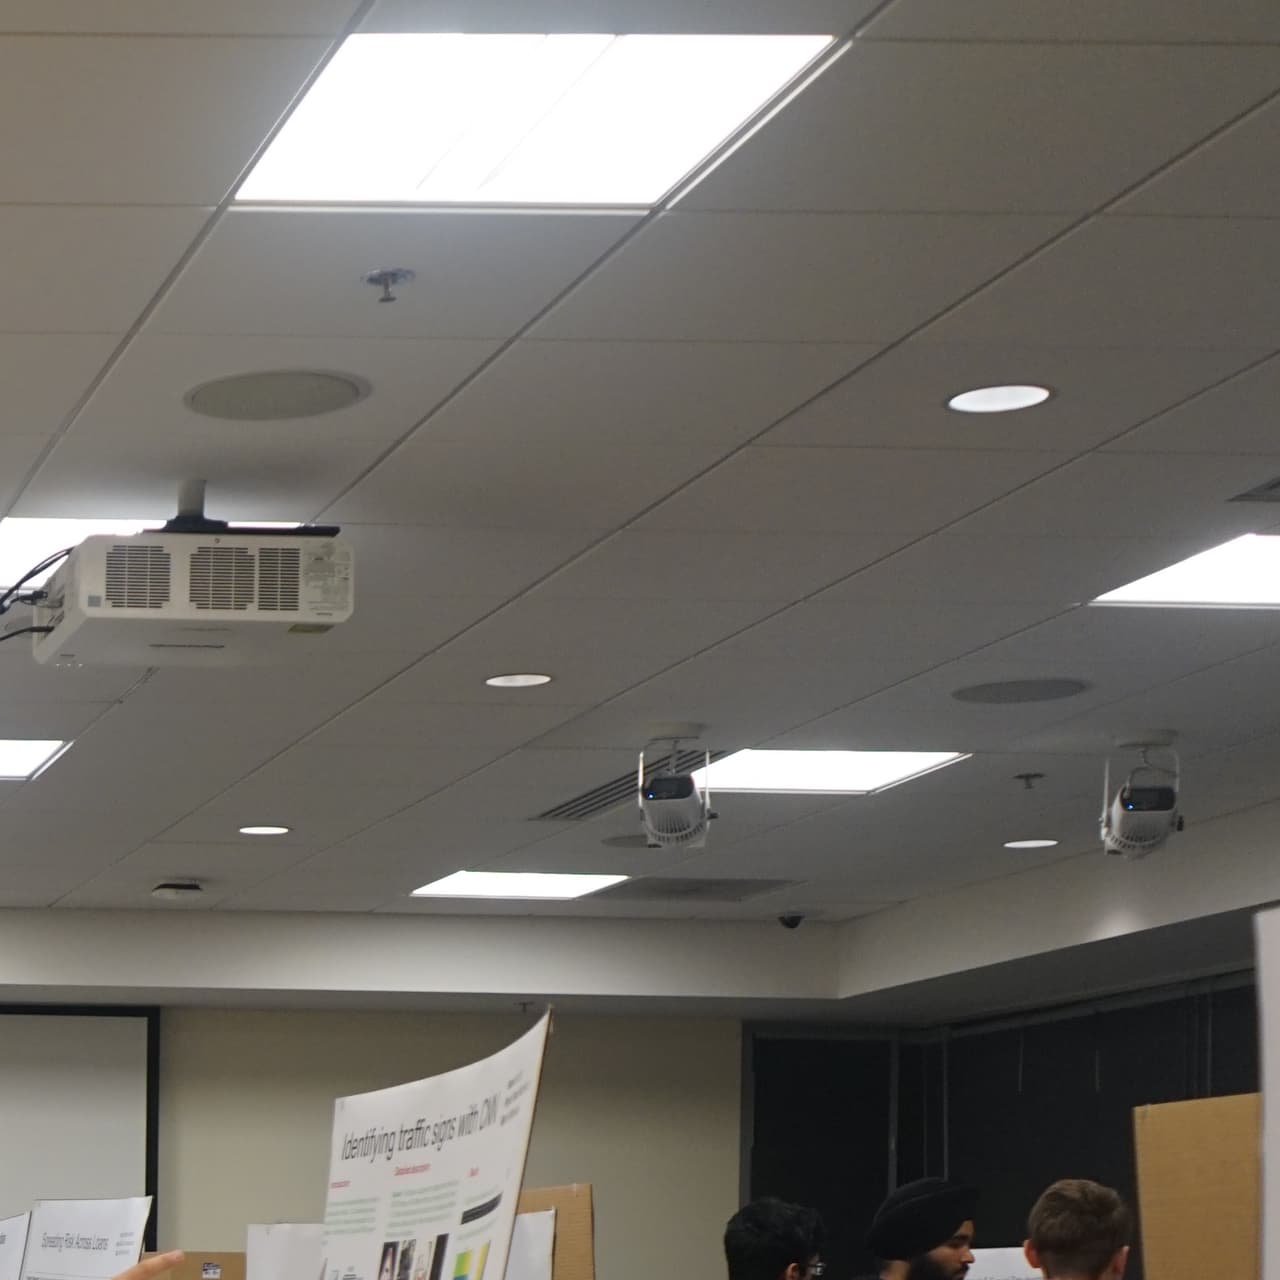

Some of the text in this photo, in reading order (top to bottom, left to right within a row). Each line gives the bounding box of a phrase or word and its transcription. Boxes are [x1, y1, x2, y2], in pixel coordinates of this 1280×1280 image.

[341, 1126, 395, 1163] Identifying
[398, 1118, 430, 1151] traffic
[431, 1113, 457, 1152] signs
[458, 1103, 479, 1138] with
